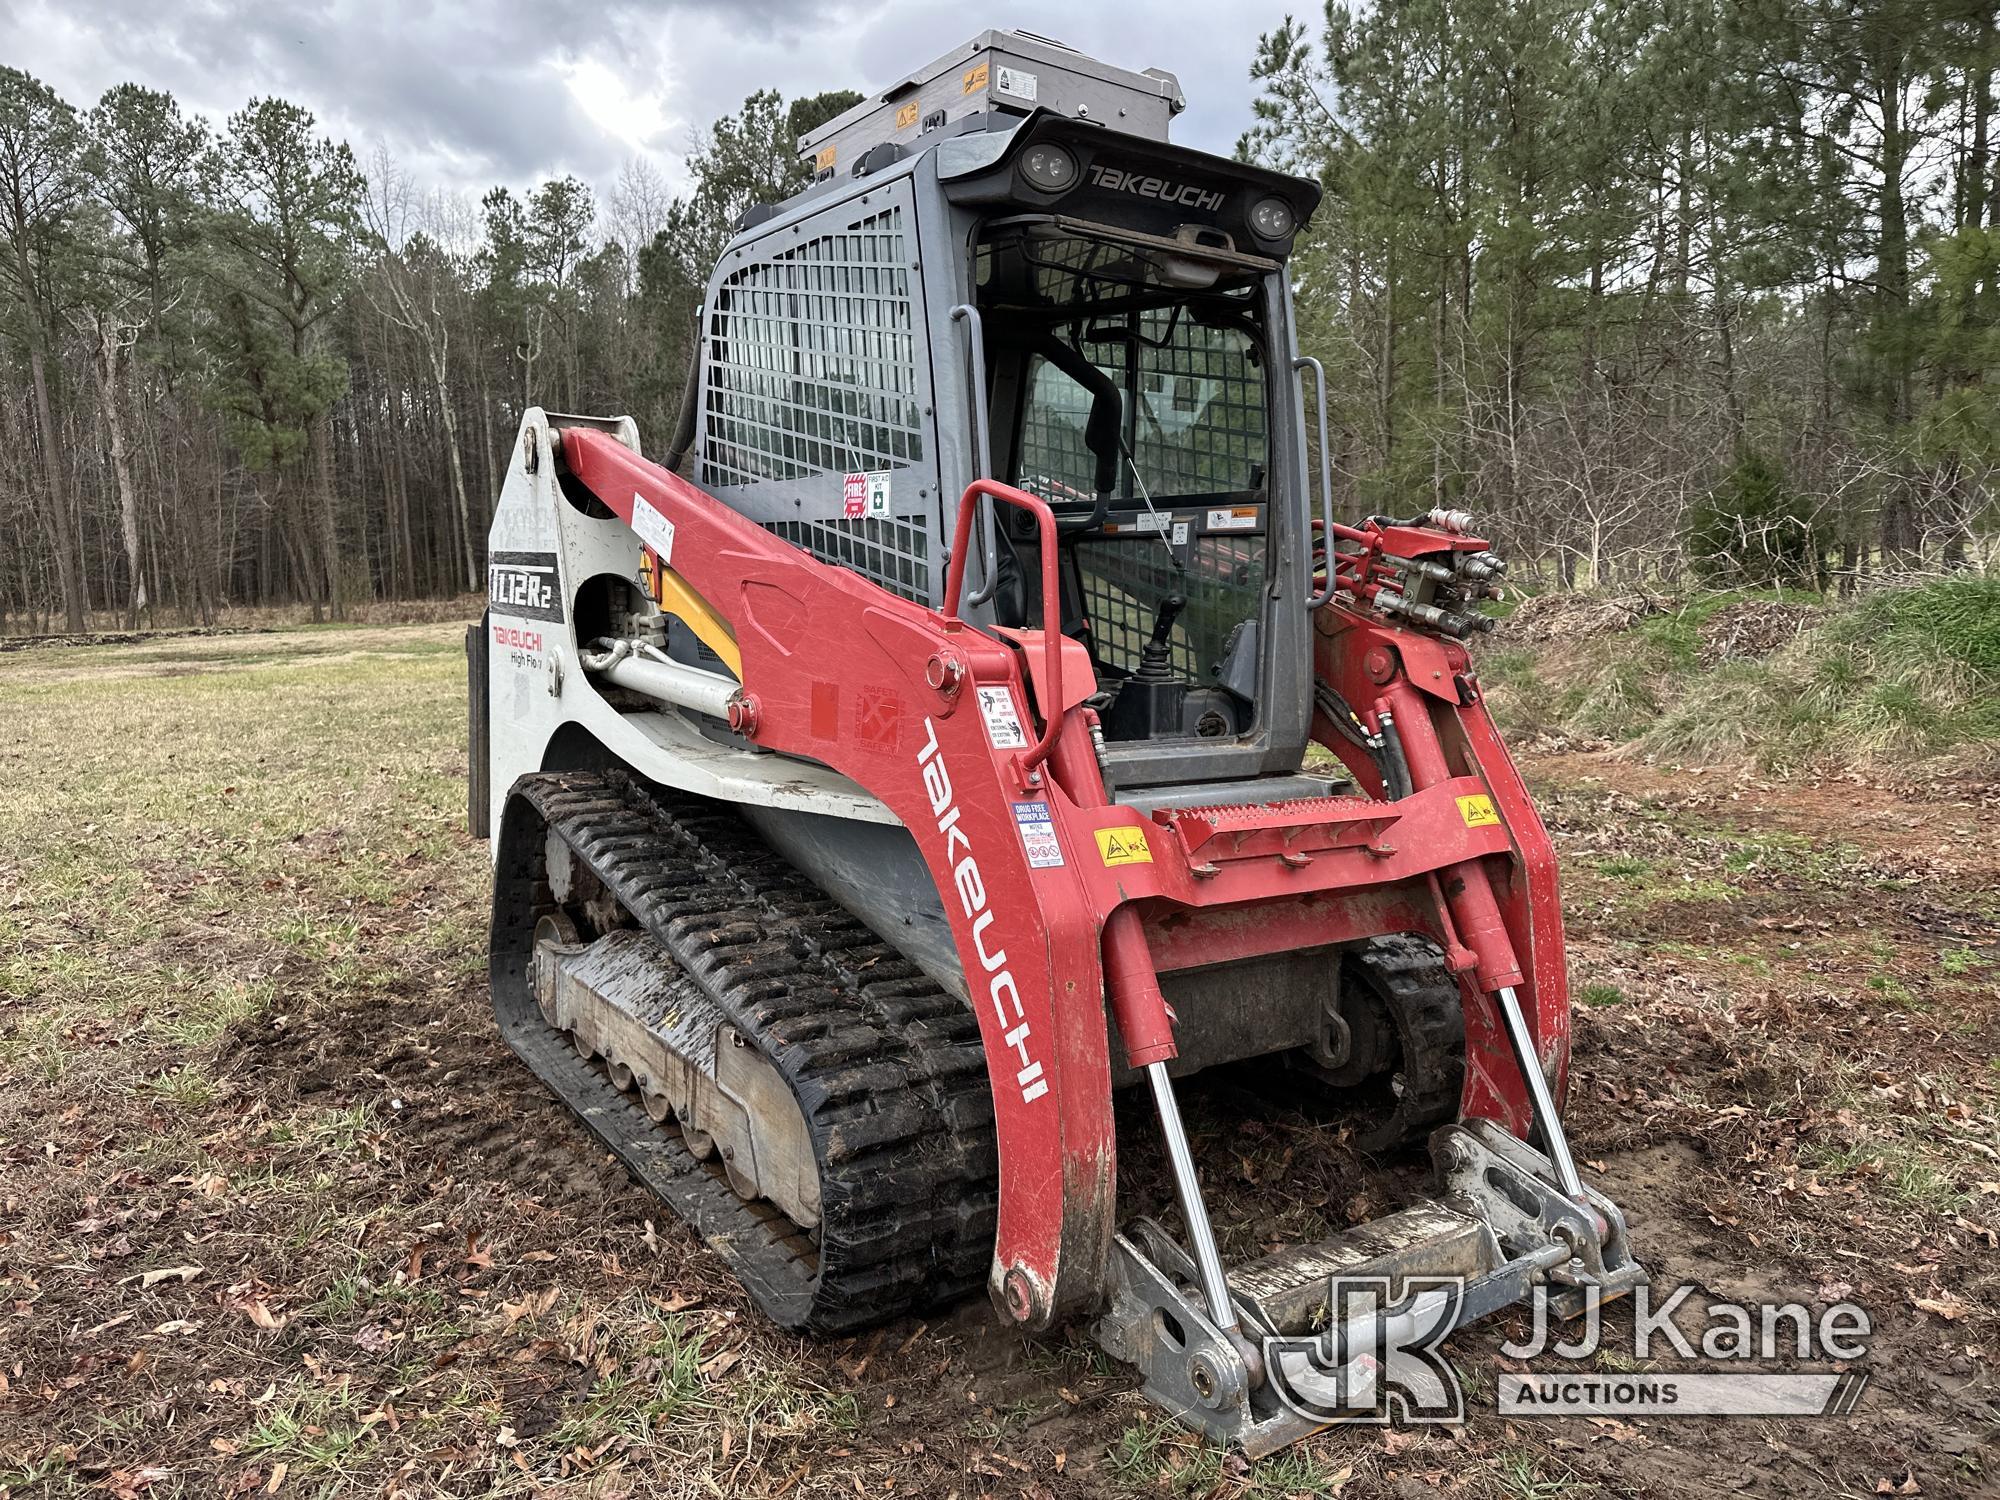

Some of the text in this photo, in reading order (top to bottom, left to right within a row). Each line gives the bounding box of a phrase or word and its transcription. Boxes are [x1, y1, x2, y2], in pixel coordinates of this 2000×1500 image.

[847, 482, 863, 498] FIRE
[511, 652, 526, 668] High
[1015, 803, 1047, 814] DRUG FREE
[1016, 812, 1050, 821] WORKPLACE
